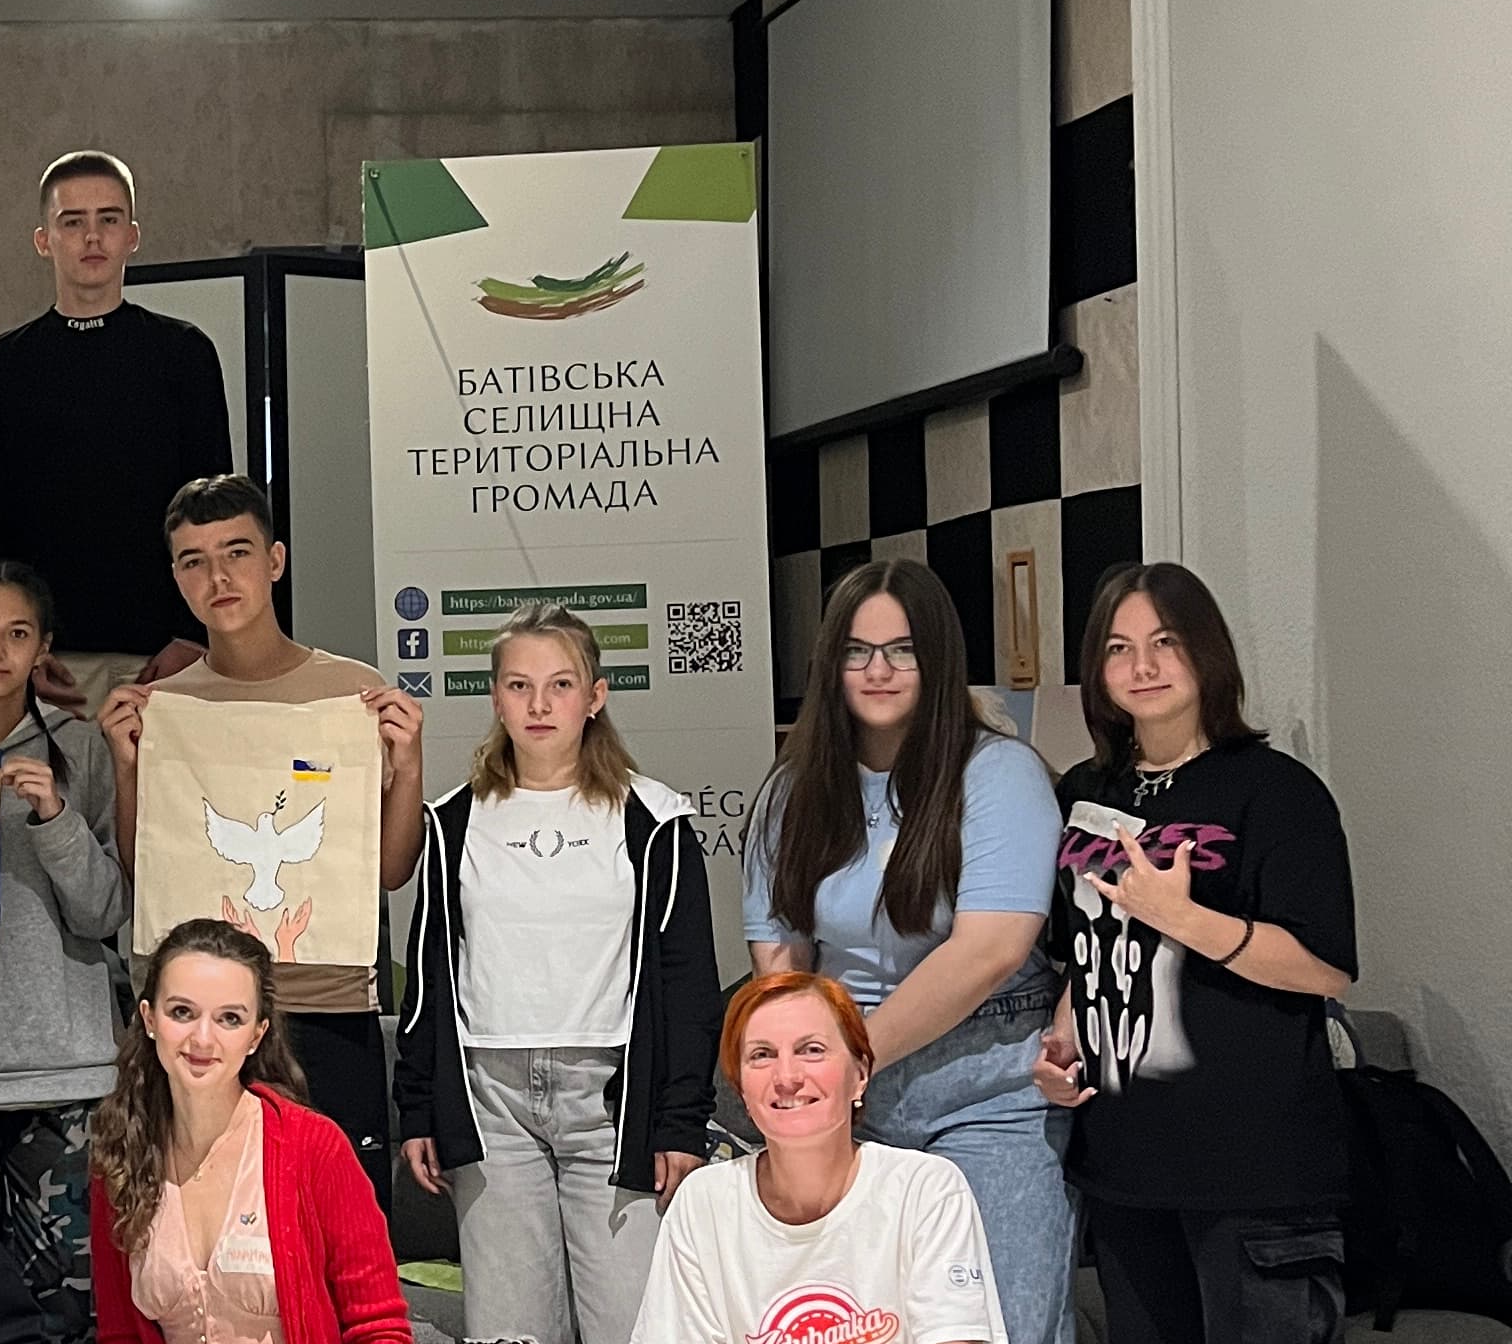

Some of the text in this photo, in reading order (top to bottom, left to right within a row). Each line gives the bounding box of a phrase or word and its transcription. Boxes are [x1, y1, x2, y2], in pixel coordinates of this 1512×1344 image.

[457, 359, 665, 396] БАТІВСЬКА
[463, 399, 661, 434] СЕЛИЩНА
[407, 436, 720, 476] ТЕРИТОРІАЛЬНА
[471, 479, 658, 513] ГРОМАДА
